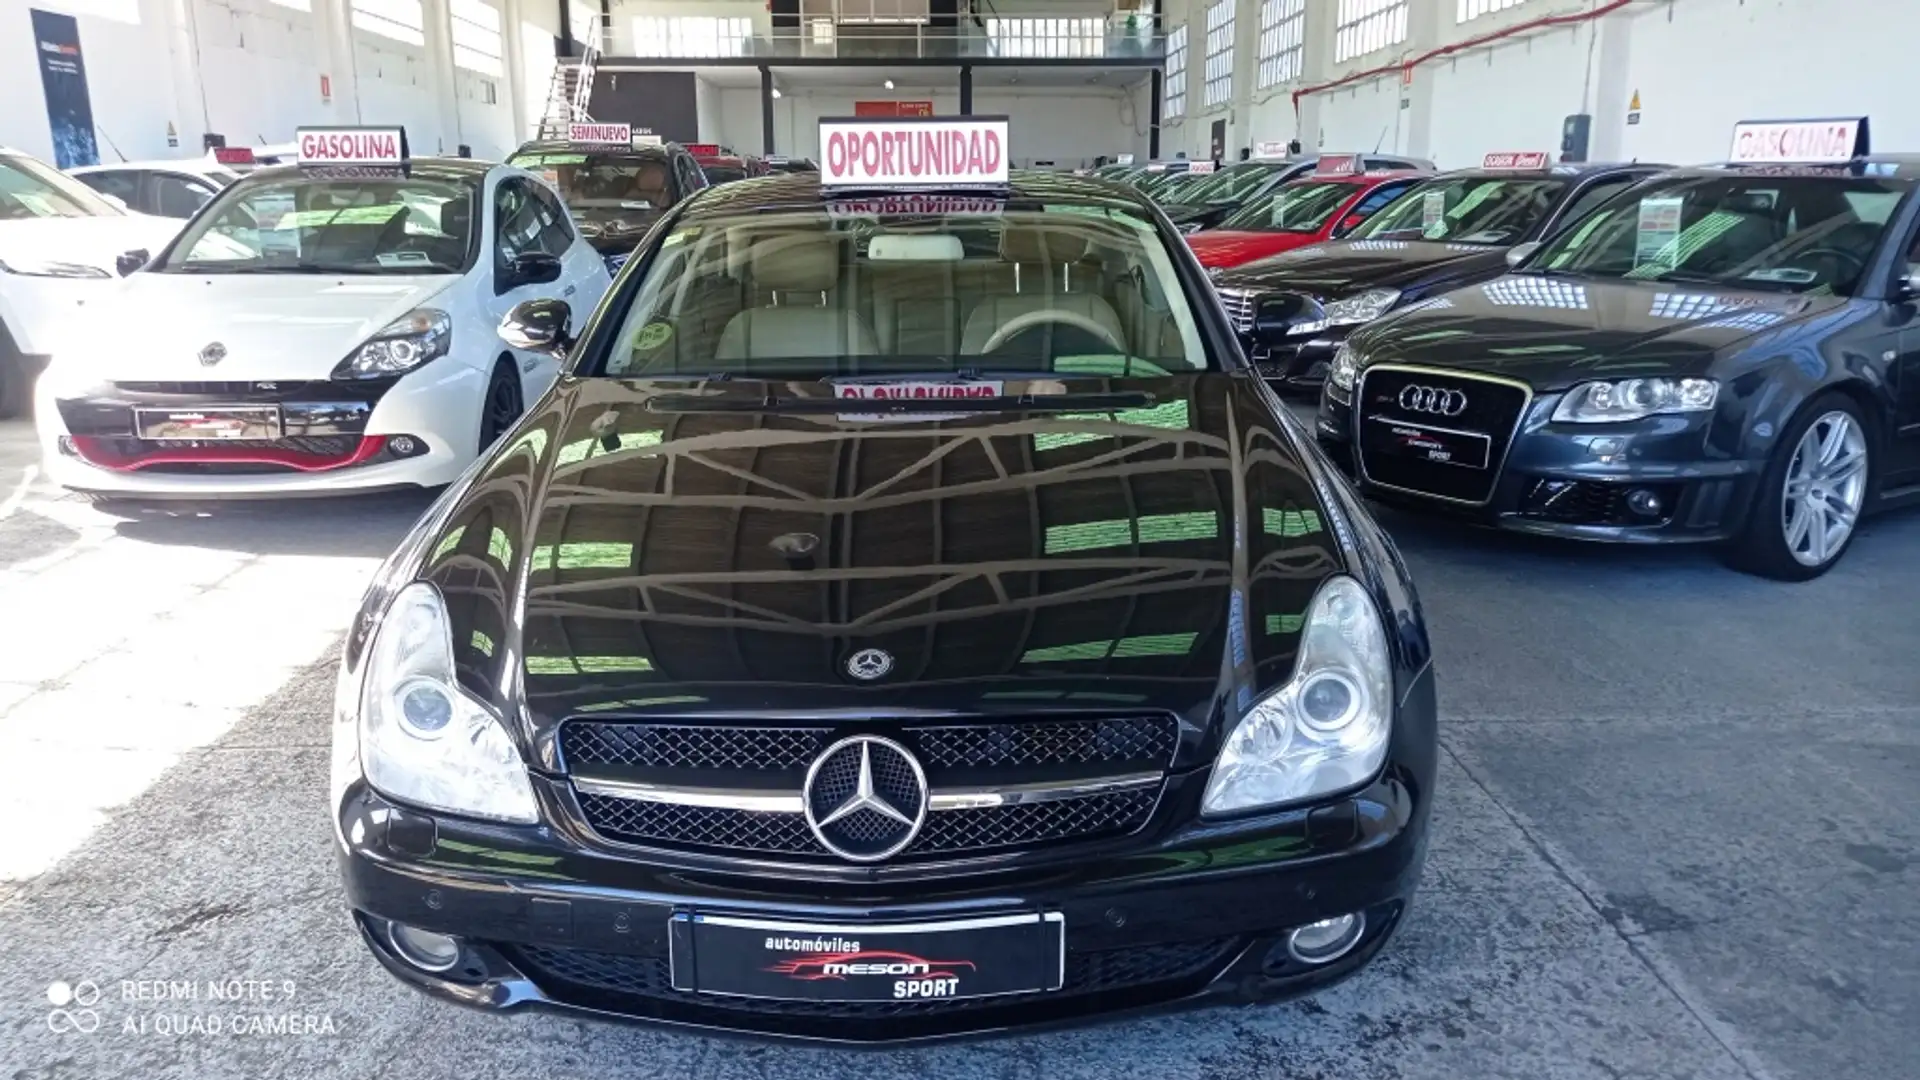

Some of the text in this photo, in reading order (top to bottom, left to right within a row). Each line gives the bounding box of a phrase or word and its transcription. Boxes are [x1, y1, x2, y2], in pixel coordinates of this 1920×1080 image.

[571, 126, 629, 141] SEMINUEVO
[303, 134, 397, 159] GASOLINA
[828, 130, 1001, 177] OPORTUNIDAD
[765, 936, 860, 953] automóviles
[894, 978, 959, 999] SPORT
